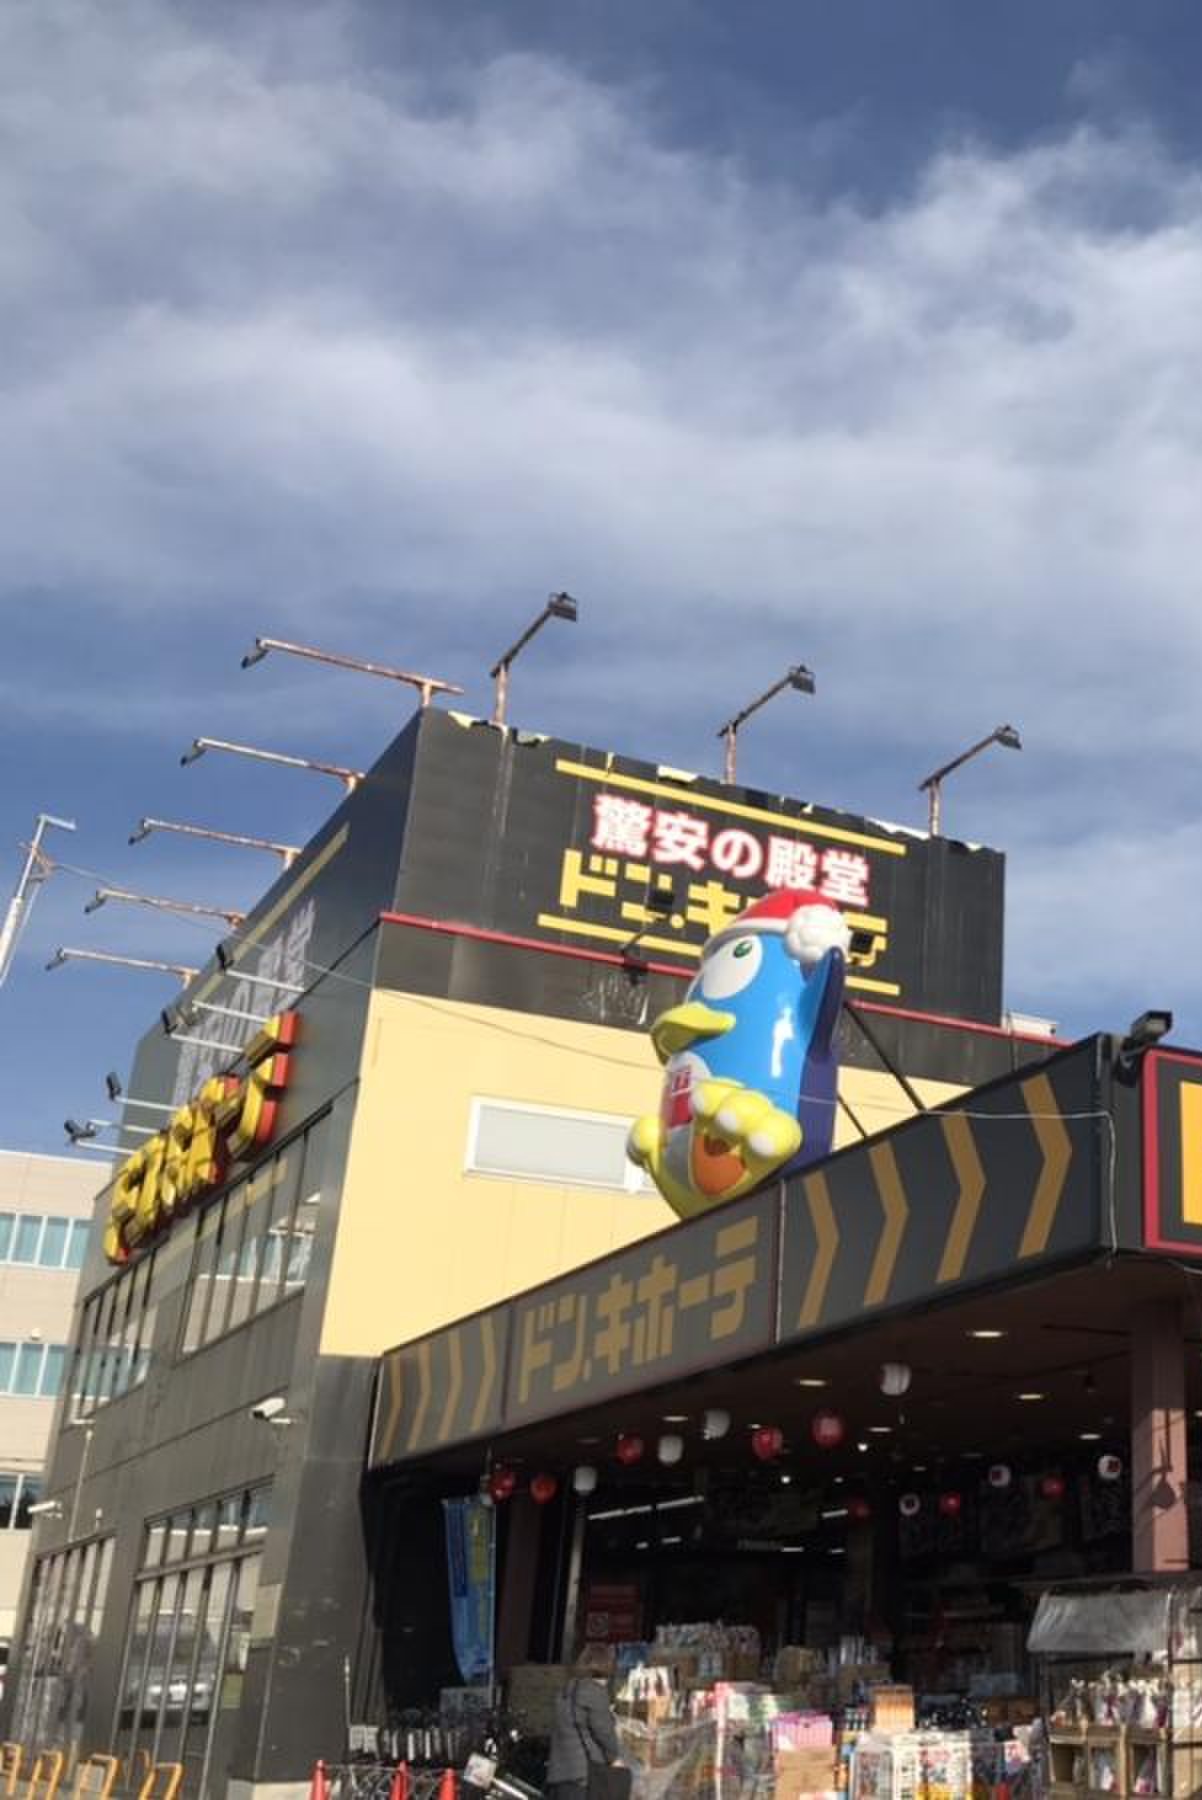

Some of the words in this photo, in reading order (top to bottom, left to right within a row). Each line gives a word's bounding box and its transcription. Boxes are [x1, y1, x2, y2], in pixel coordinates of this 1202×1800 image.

[592, 794, 870, 907] 驚安の殿堂
